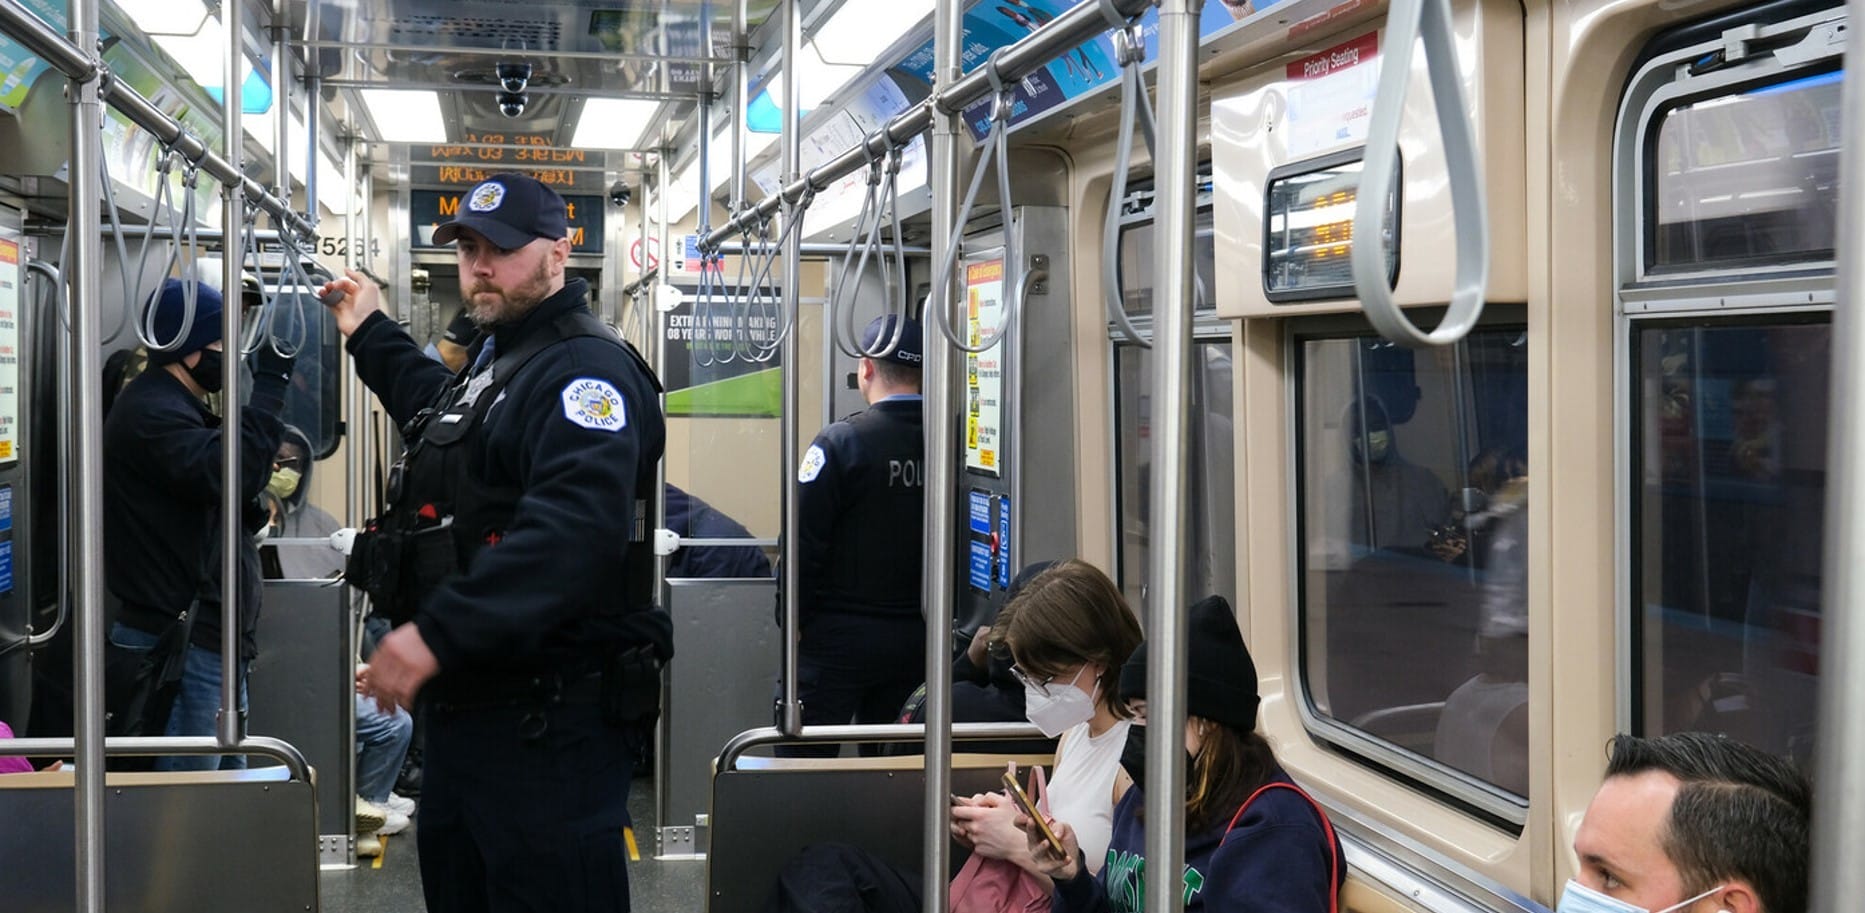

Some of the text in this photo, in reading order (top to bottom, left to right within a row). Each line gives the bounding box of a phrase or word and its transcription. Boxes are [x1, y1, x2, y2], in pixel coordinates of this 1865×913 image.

[1303, 48, 1359, 77] Priority Seating
[897, 350, 922, 362] CPD
[569, 381, 619, 406] CHICAGO
[575, 409, 619, 427] POLICE
[888, 459, 923, 488] POL
